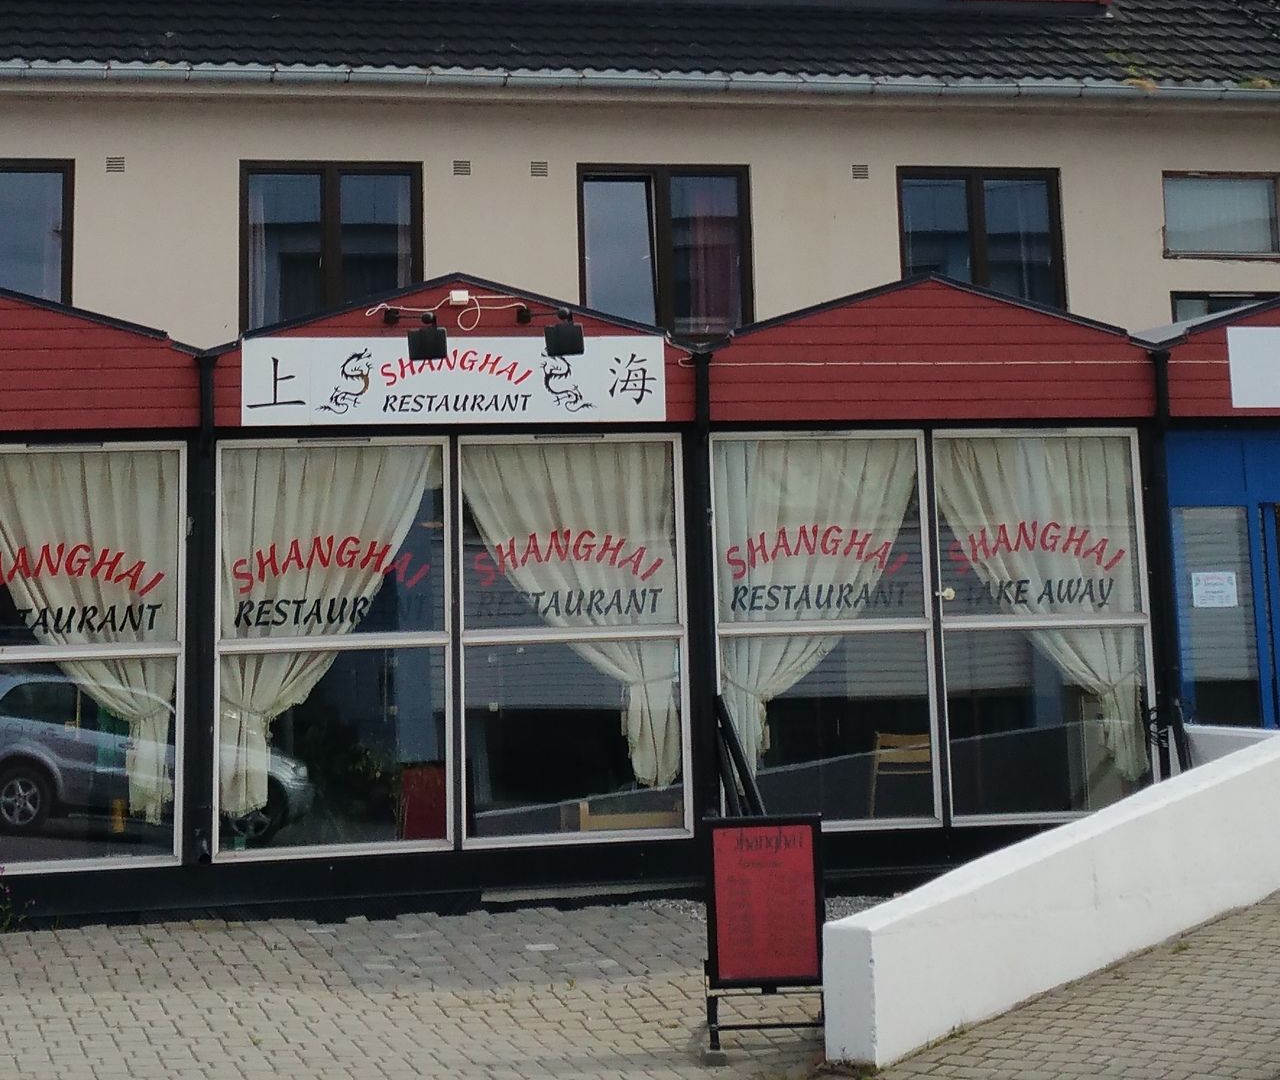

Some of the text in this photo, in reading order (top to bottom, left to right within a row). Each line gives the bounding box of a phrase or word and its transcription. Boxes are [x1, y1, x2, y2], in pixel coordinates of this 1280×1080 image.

[246, 356, 306, 410] 上
[380, 348, 533, 387] SHANGHAI
[608, 353, 657, 405] 海
[382, 393, 532, 413] RESTAURANT
[232, 535, 430, 594] SHANGHAI
[474, 529, 662, 586] SHANGHAI
[727, 524, 908, 579] SHANGHAI
[950, 520, 1125, 575] SHANGHAI
[234, 595, 371, 629] RESTAUR
[1037, 576, 1115, 609] AWAY
[16, 603, 164, 636] TAURANT
